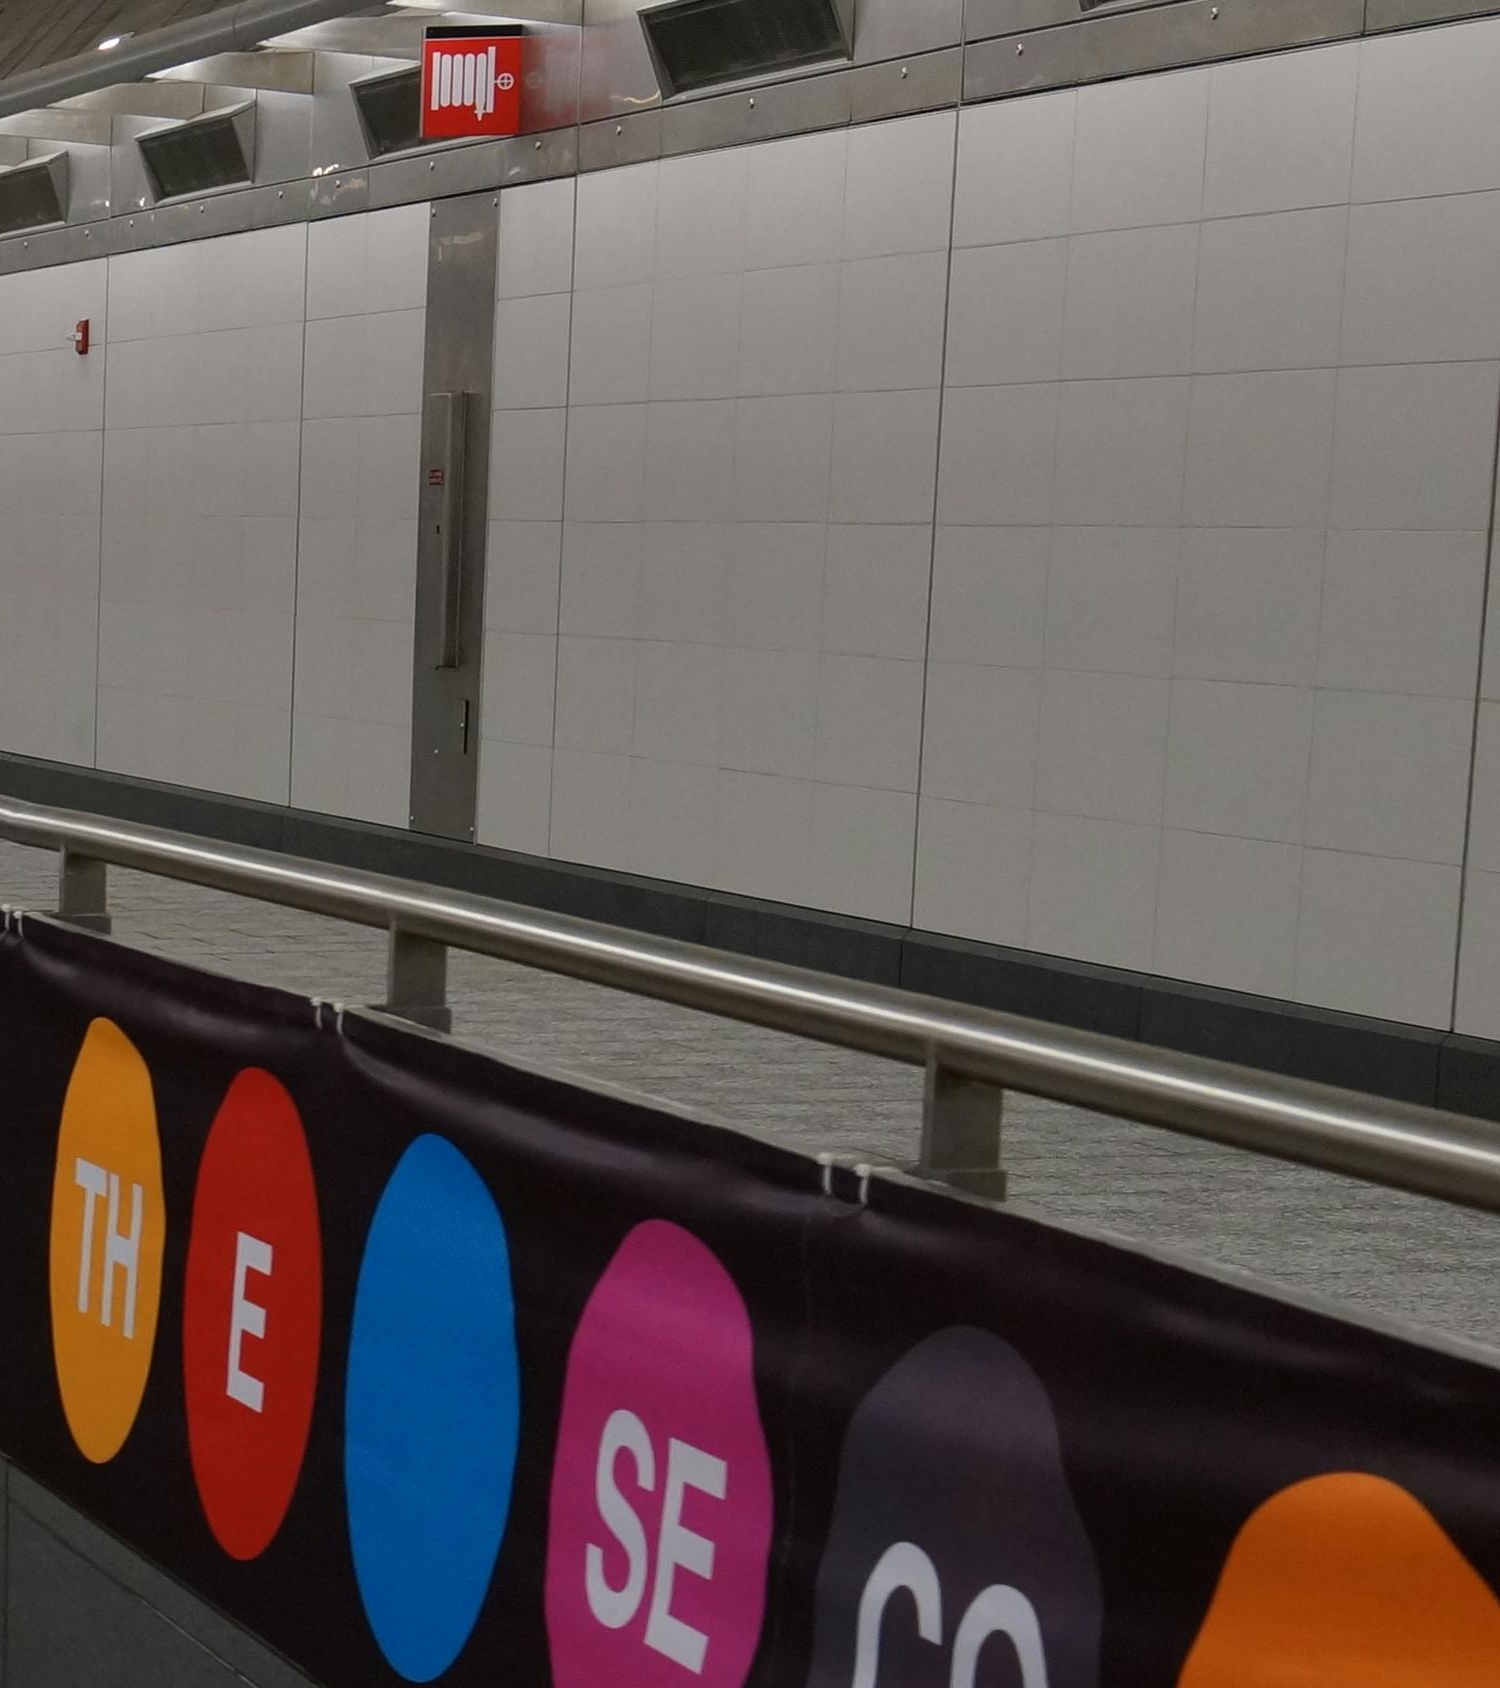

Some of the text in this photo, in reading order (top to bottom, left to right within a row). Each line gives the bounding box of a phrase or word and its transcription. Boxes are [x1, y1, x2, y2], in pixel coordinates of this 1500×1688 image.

[74, 1156, 144, 1340] TH
[225, 1230, 274, 1414] E
[585, 1409, 728, 1676] SE
